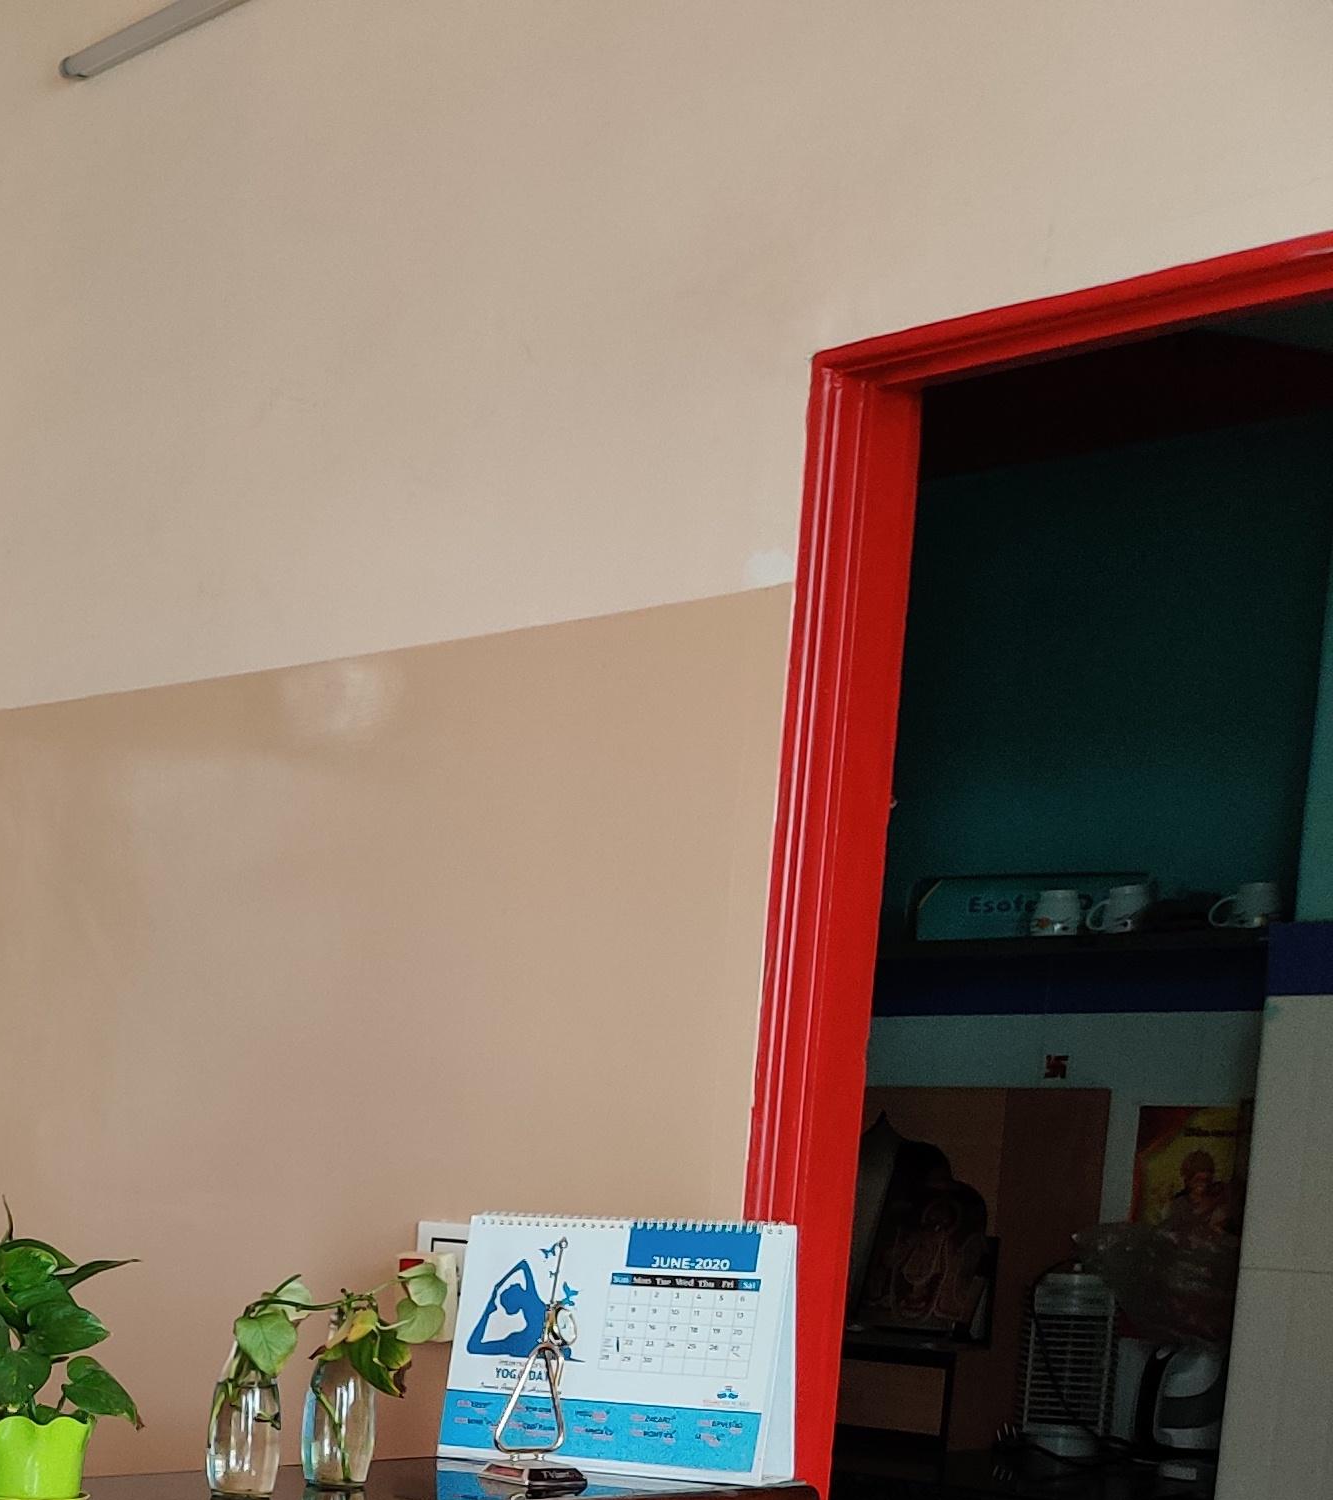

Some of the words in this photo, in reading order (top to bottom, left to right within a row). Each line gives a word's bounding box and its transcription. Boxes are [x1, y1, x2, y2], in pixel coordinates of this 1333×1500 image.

[651, 1256, 730, 1271] JUNE-2020
[612, 1275, 631, 1284] Sun
[632, 1276, 652, 1285] Mon
[656, 1278, 672, 1286] Tue
[675, 1279, 695, 1287] Wed
[698, 1280, 715, 1289] Thu
[721, 1281, 734, 1289] Fri
[743, 1281, 756, 1290] Sat
[690, 1326, 698, 1334] 18
[713, 1327, 721, 1335] 19
